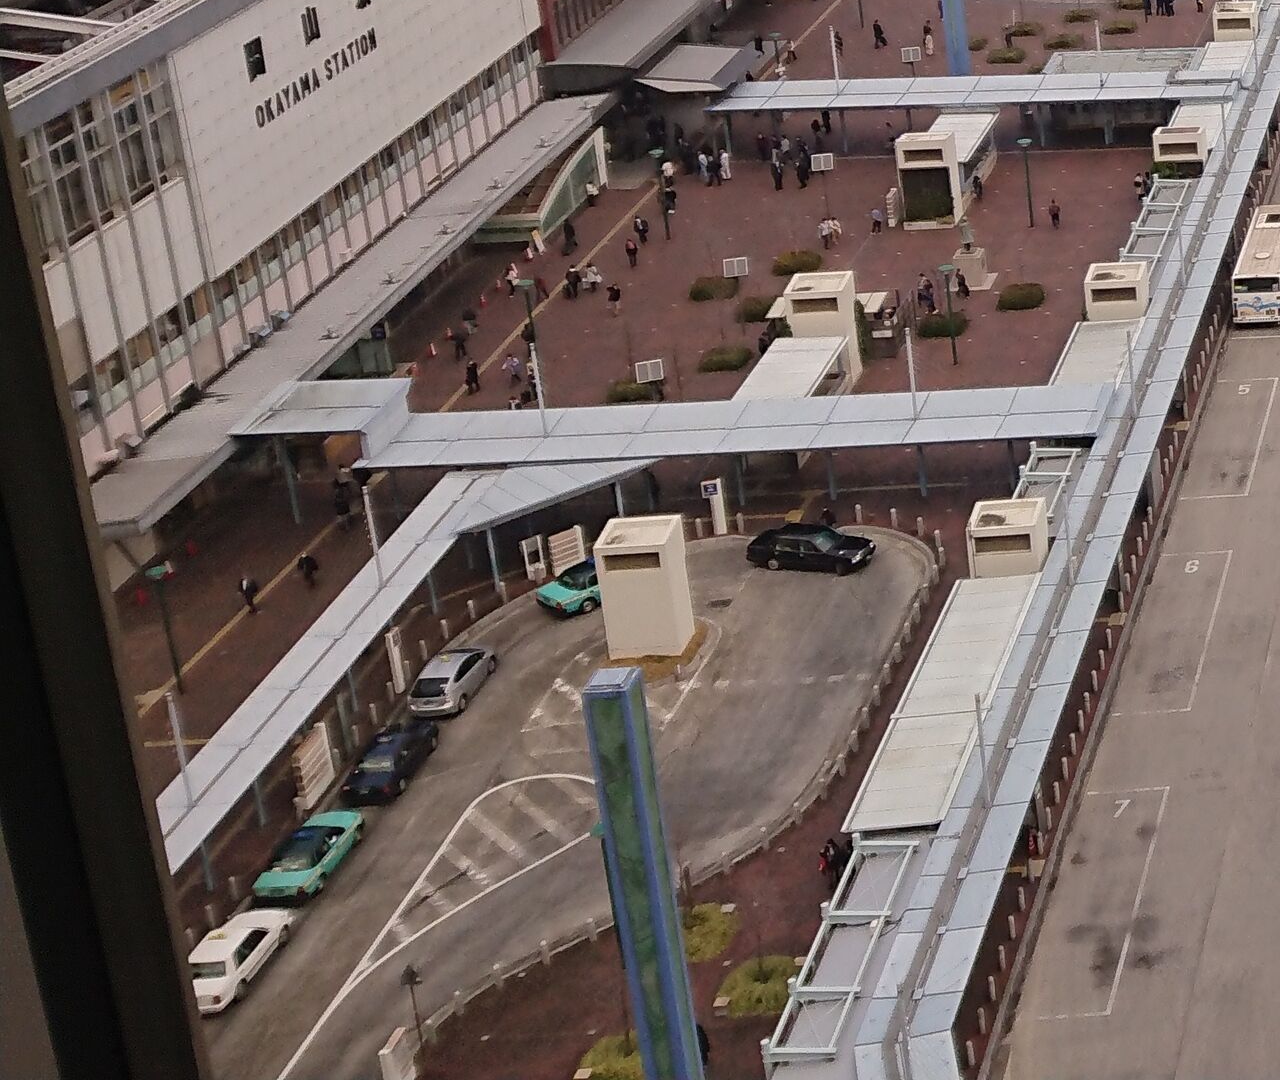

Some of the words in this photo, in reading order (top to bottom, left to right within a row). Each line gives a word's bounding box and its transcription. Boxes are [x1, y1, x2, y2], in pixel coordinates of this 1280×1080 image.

[255, 68, 320, 129] OKAYAMA
[323, 27, 377, 81] STATION
[1238, 384, 1250, 395] 5
[1184, 560, 1198, 574] 6
[1113, 799, 1130, 818] 7
